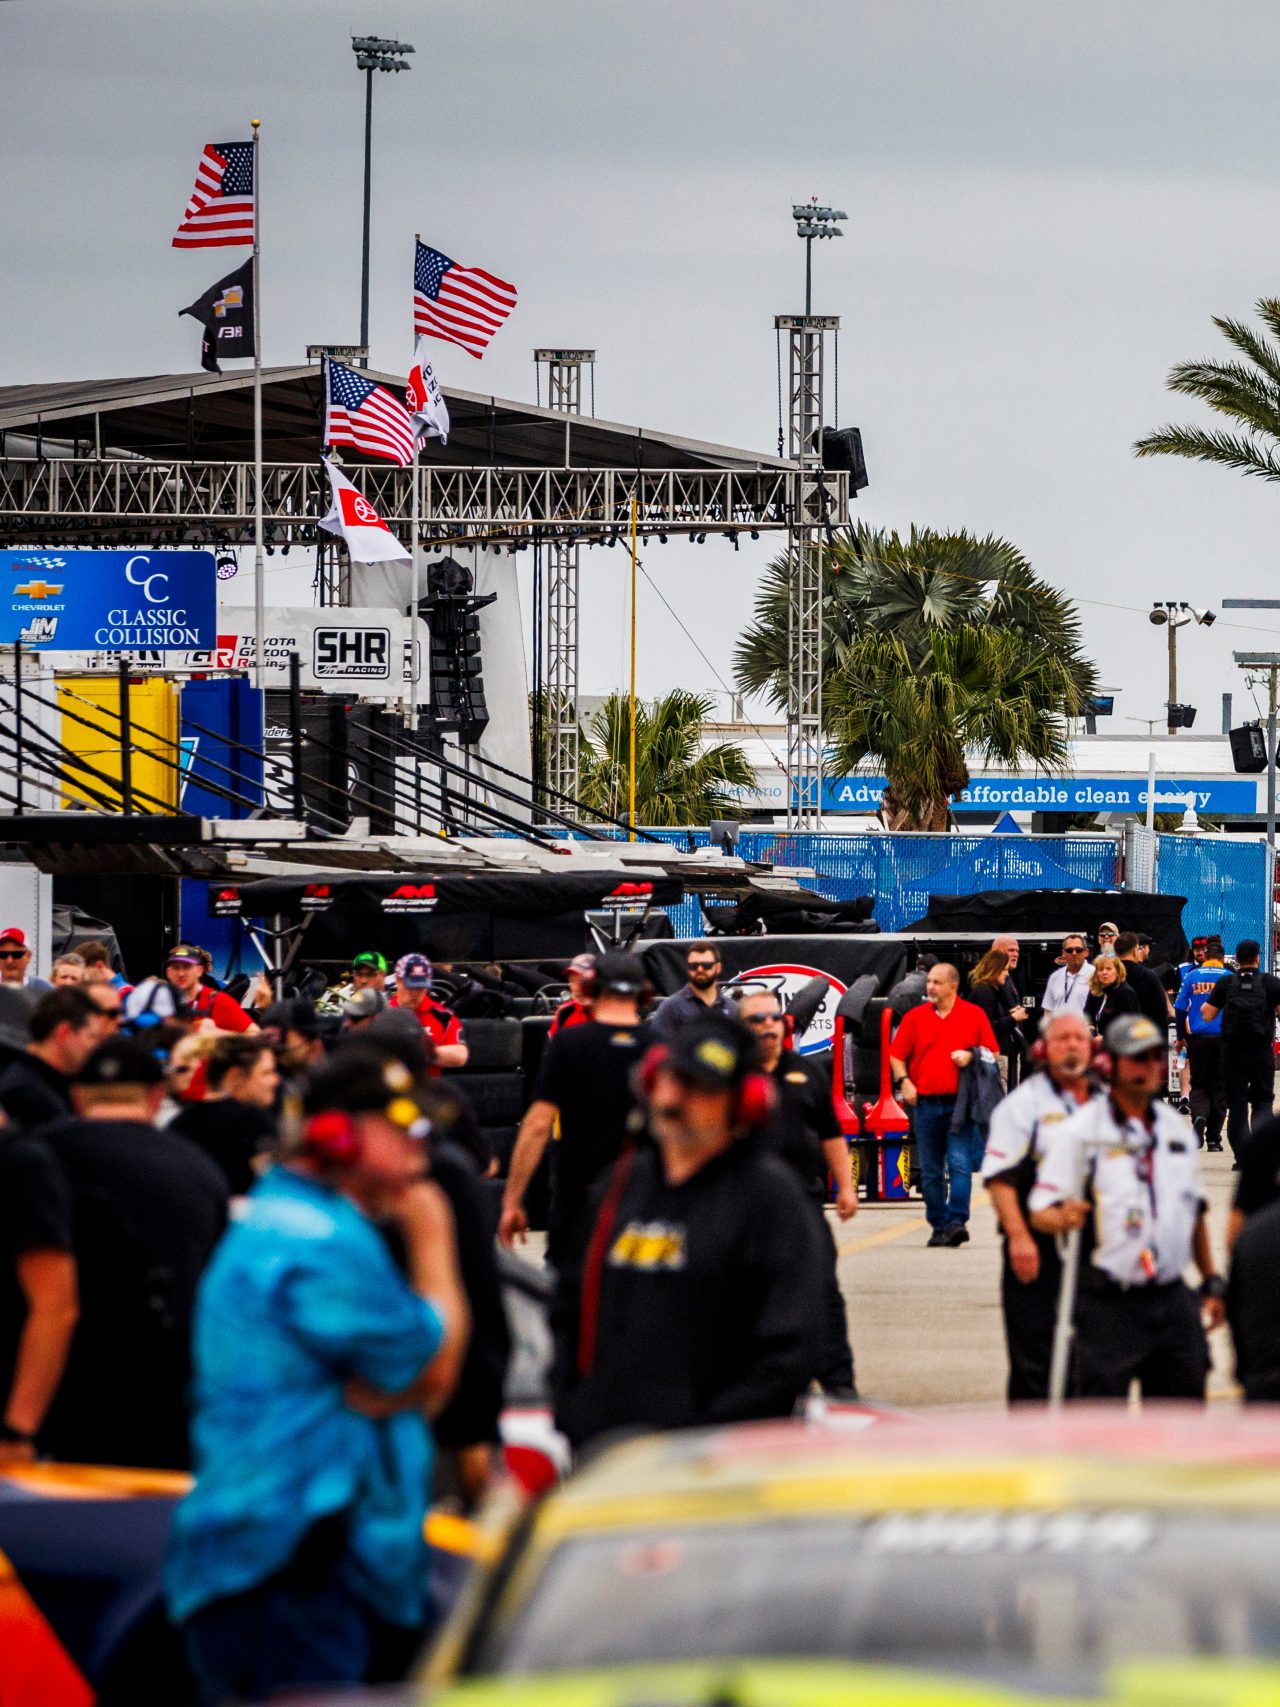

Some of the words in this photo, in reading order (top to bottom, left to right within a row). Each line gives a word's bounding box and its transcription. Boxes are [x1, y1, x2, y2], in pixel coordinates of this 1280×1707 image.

[791, 318, 826, 327] TMCAT
[108, 609, 186, 626] CLASSIC
[94, 628, 200, 645] COLLISION
[317, 632, 386, 664] SHR
[237, 658, 287, 671] Raing
[961, 786, 1068, 803] affordable
[1077, 786, 1130, 803] clean
[902, 1143, 911, 1193] UNOCO
